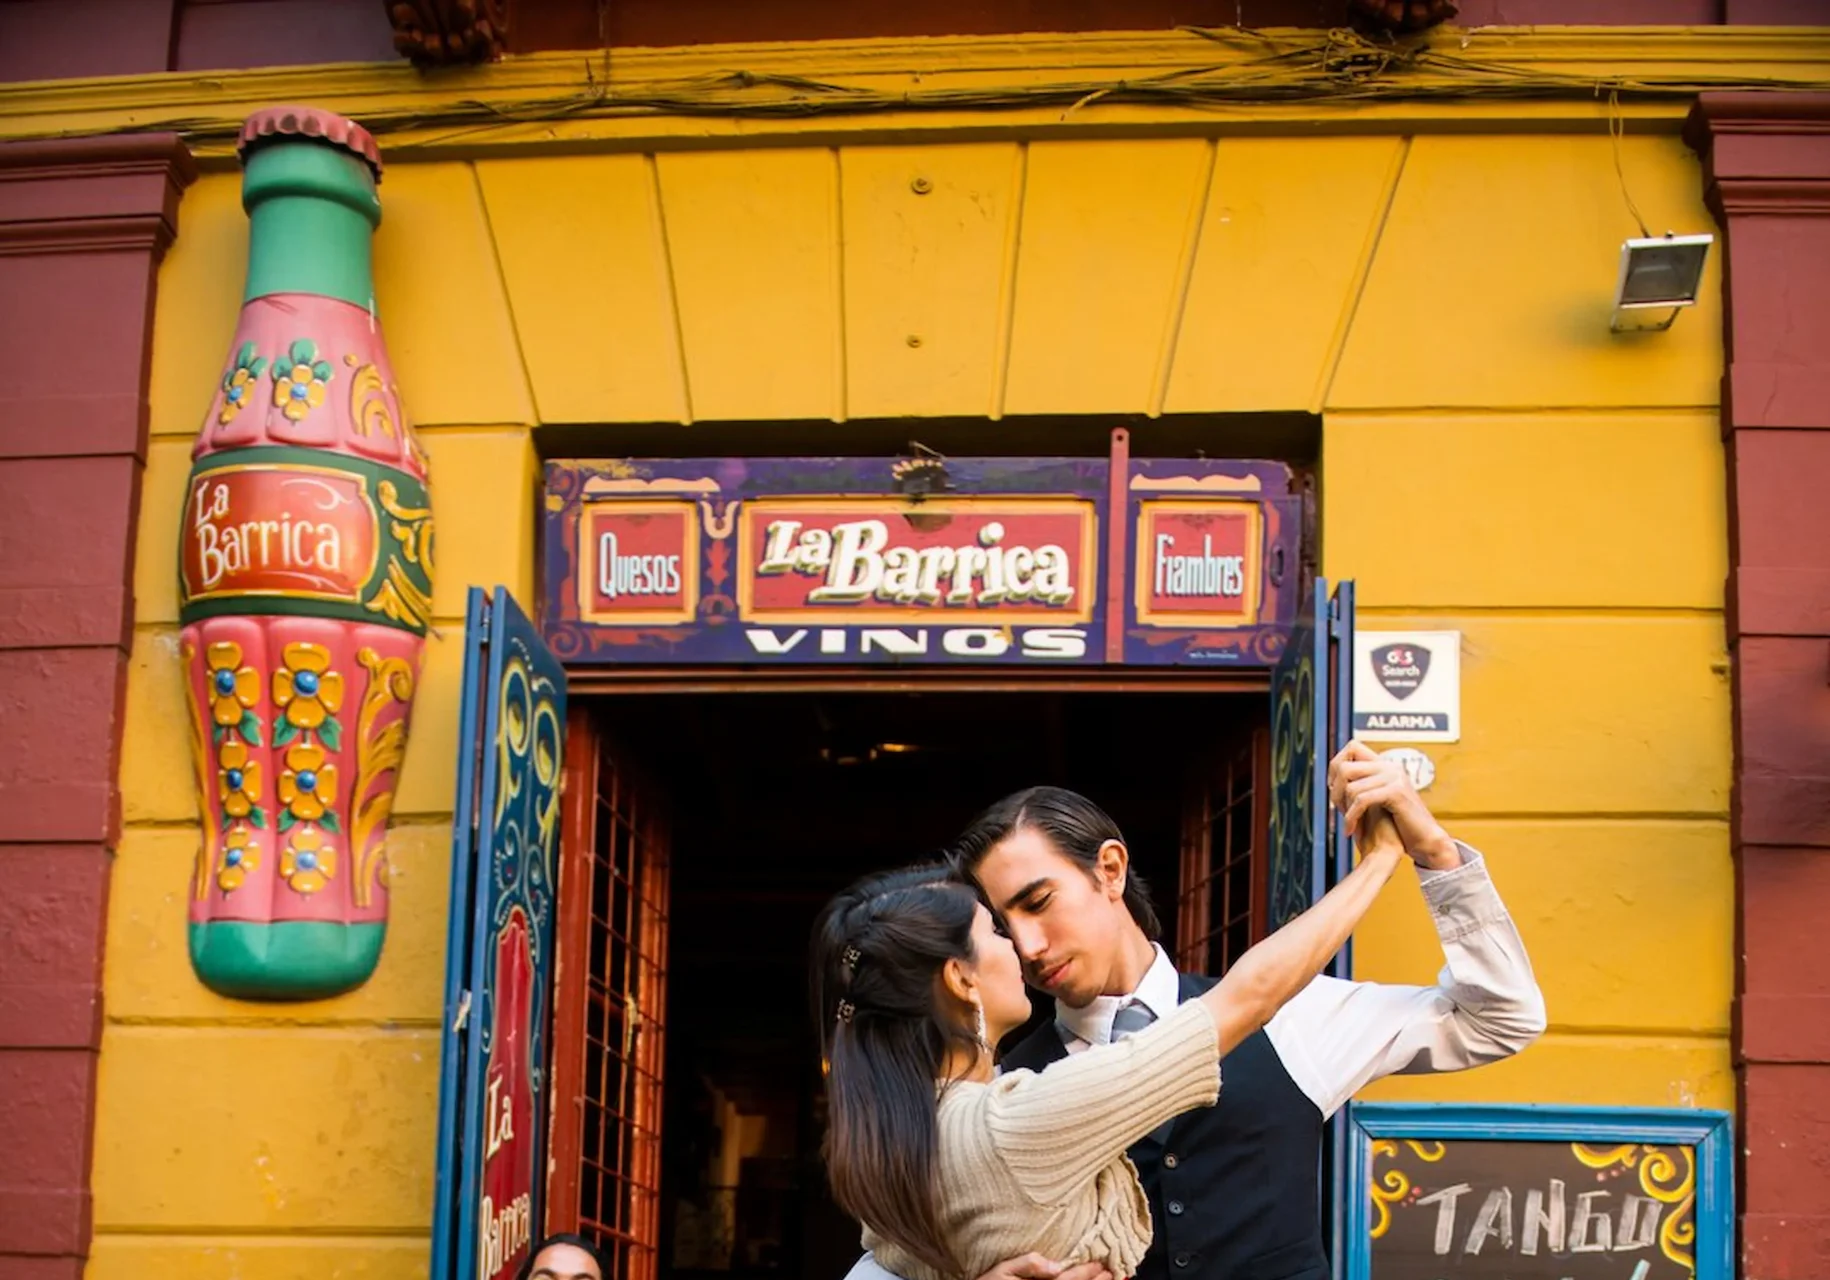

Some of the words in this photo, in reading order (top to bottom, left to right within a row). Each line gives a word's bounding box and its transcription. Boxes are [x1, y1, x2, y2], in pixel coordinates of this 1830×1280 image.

[196, 480, 230, 528] La
[196, 511, 341, 588] Barrica
[599, 531, 682, 596] Quesos
[758, 519, 831, 575] La
[808, 518, 1076, 606] Barrica
[1154, 533, 1245, 597] Fiambres
[743, 627, 1088, 658] VINOS
[1382, 665, 1420, 677] Search
[1367, 715, 1436, 729] ALARMA
[486, 1074, 514, 1160] La
[1416, 1178, 1664, 1256] TANGO
